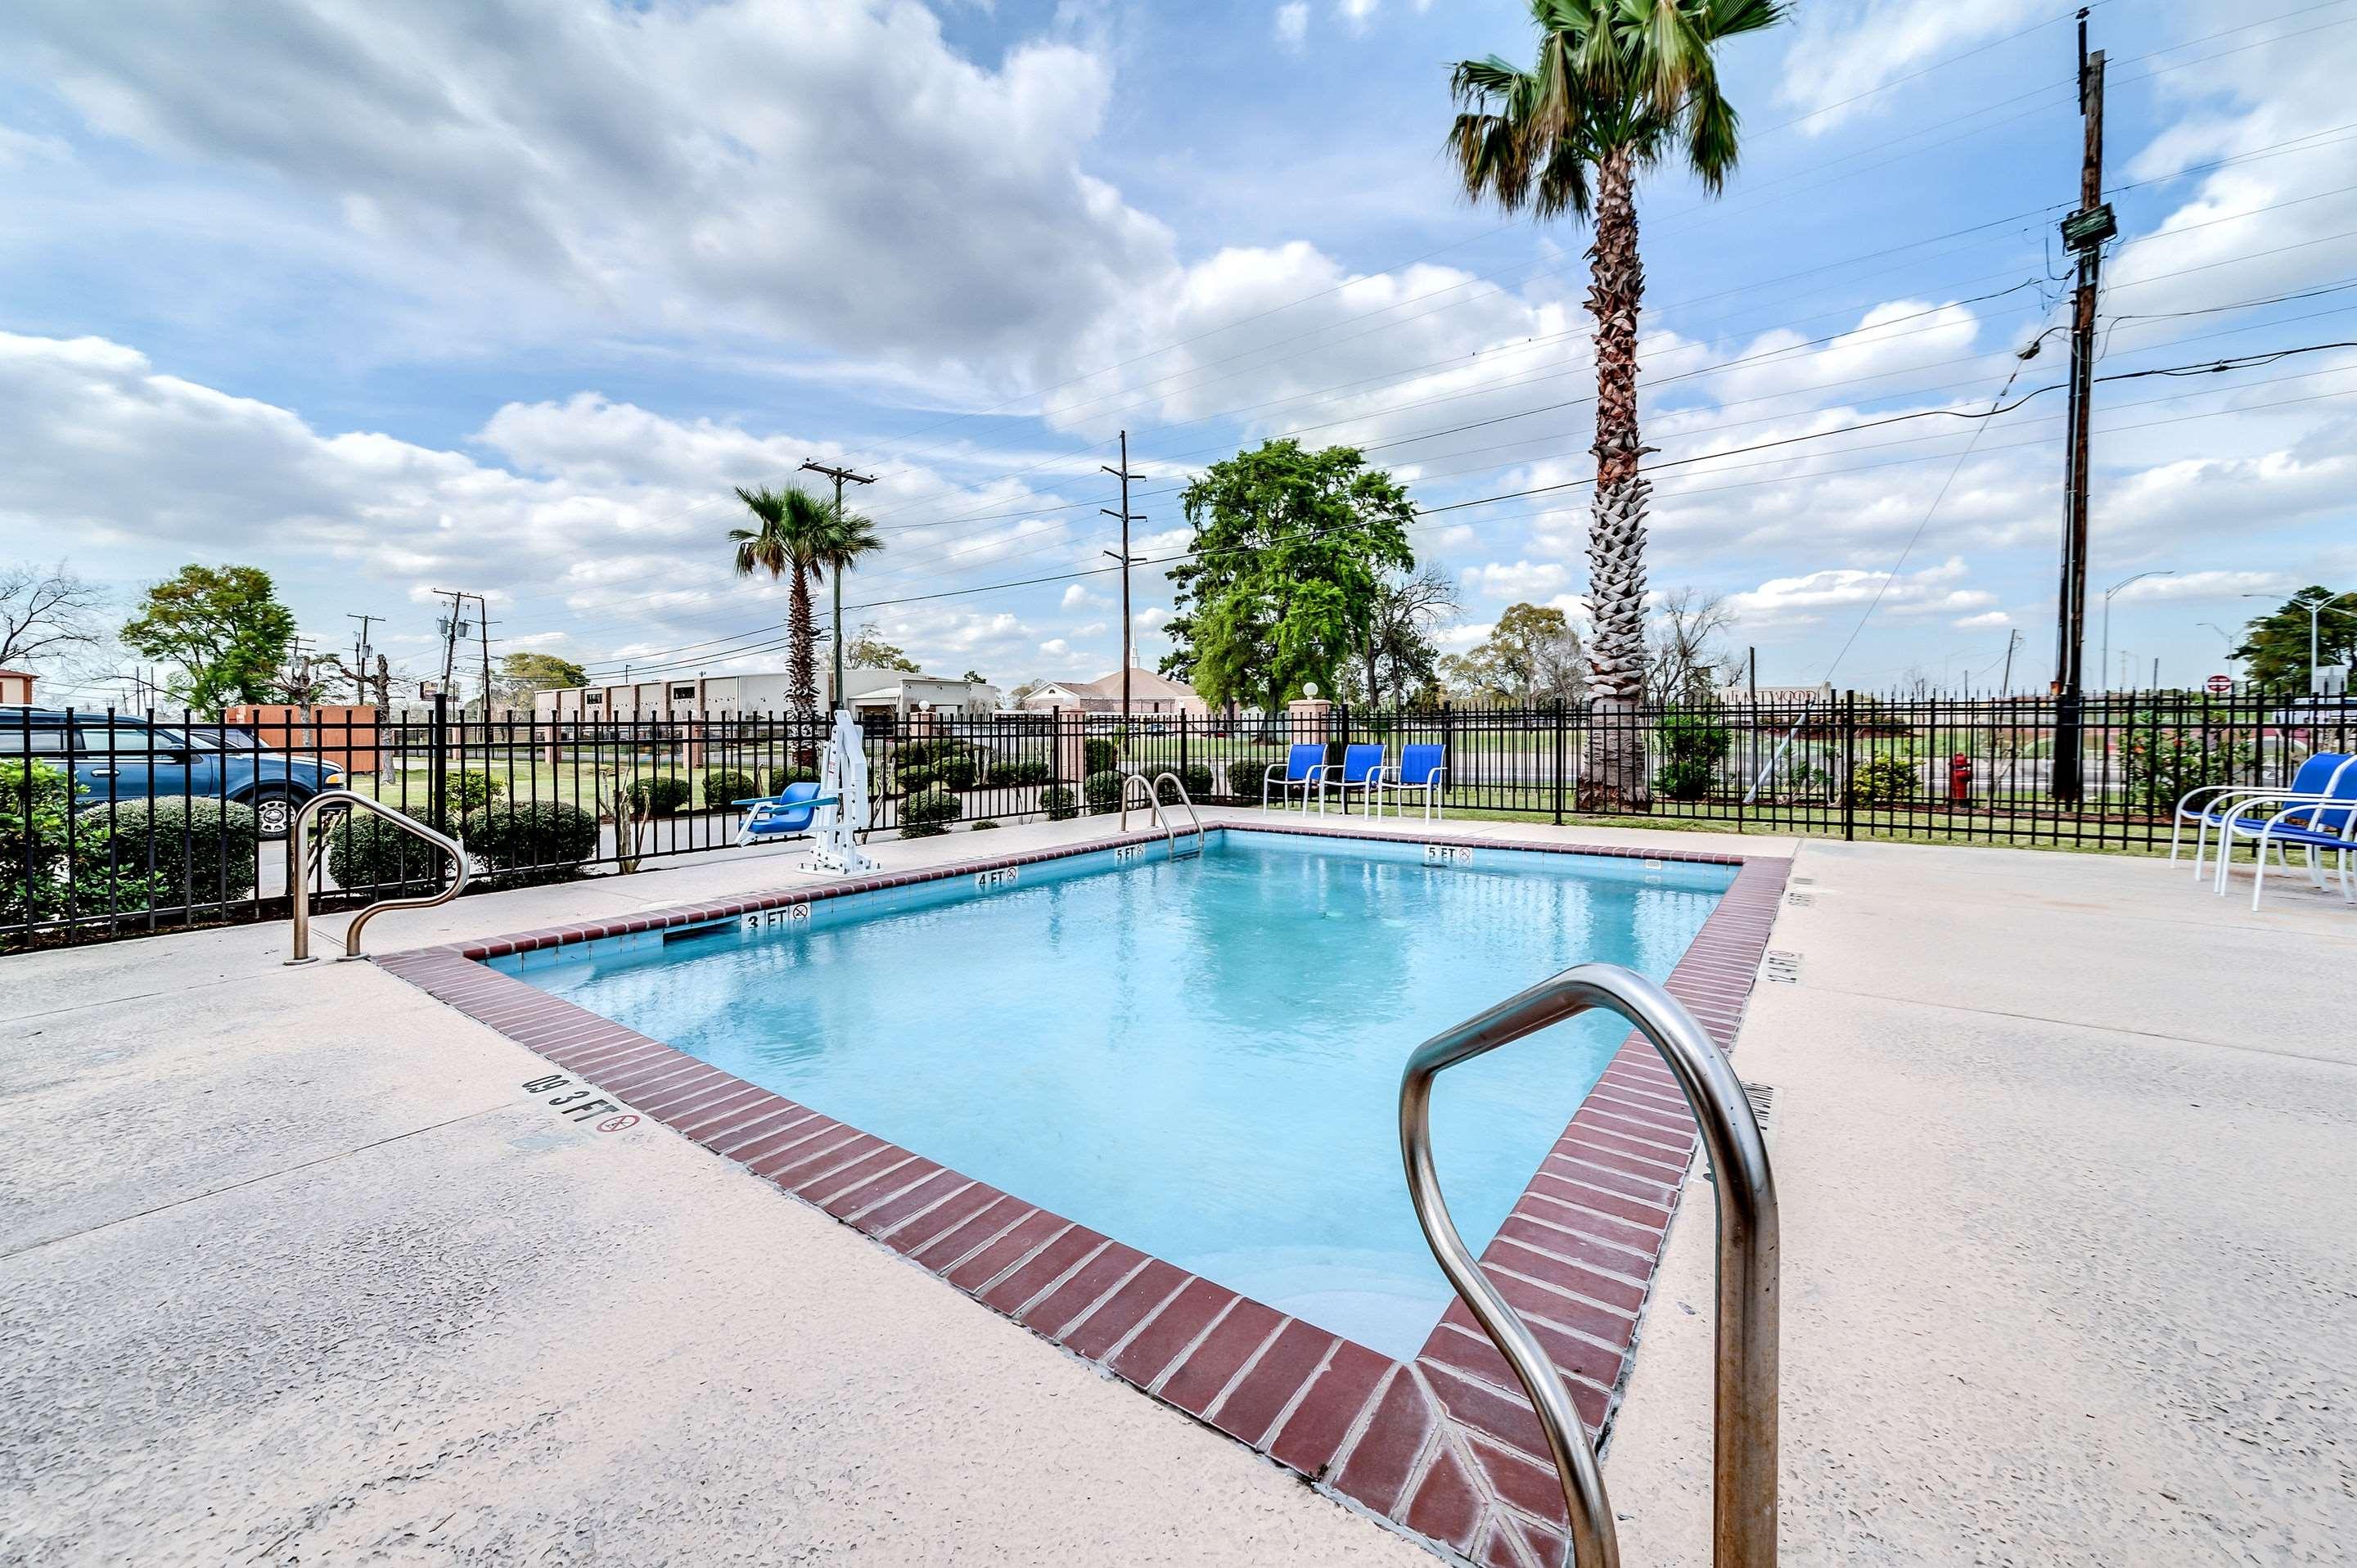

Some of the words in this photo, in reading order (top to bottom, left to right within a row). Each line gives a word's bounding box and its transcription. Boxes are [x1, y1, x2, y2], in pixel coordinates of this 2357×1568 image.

[1125, 846, 1135, 859] FT
[1429, 847, 1435, 857] 5
[1441, 848, 1455, 858] FT
[979, 873, 986, 885] 4
[990, 871, 1004, 883] FT
[747, 915, 759, 929] 3
[767, 909, 787, 926] FT
[548, 1091, 590, 1106] 3
[561, 1098, 620, 1123] FT
